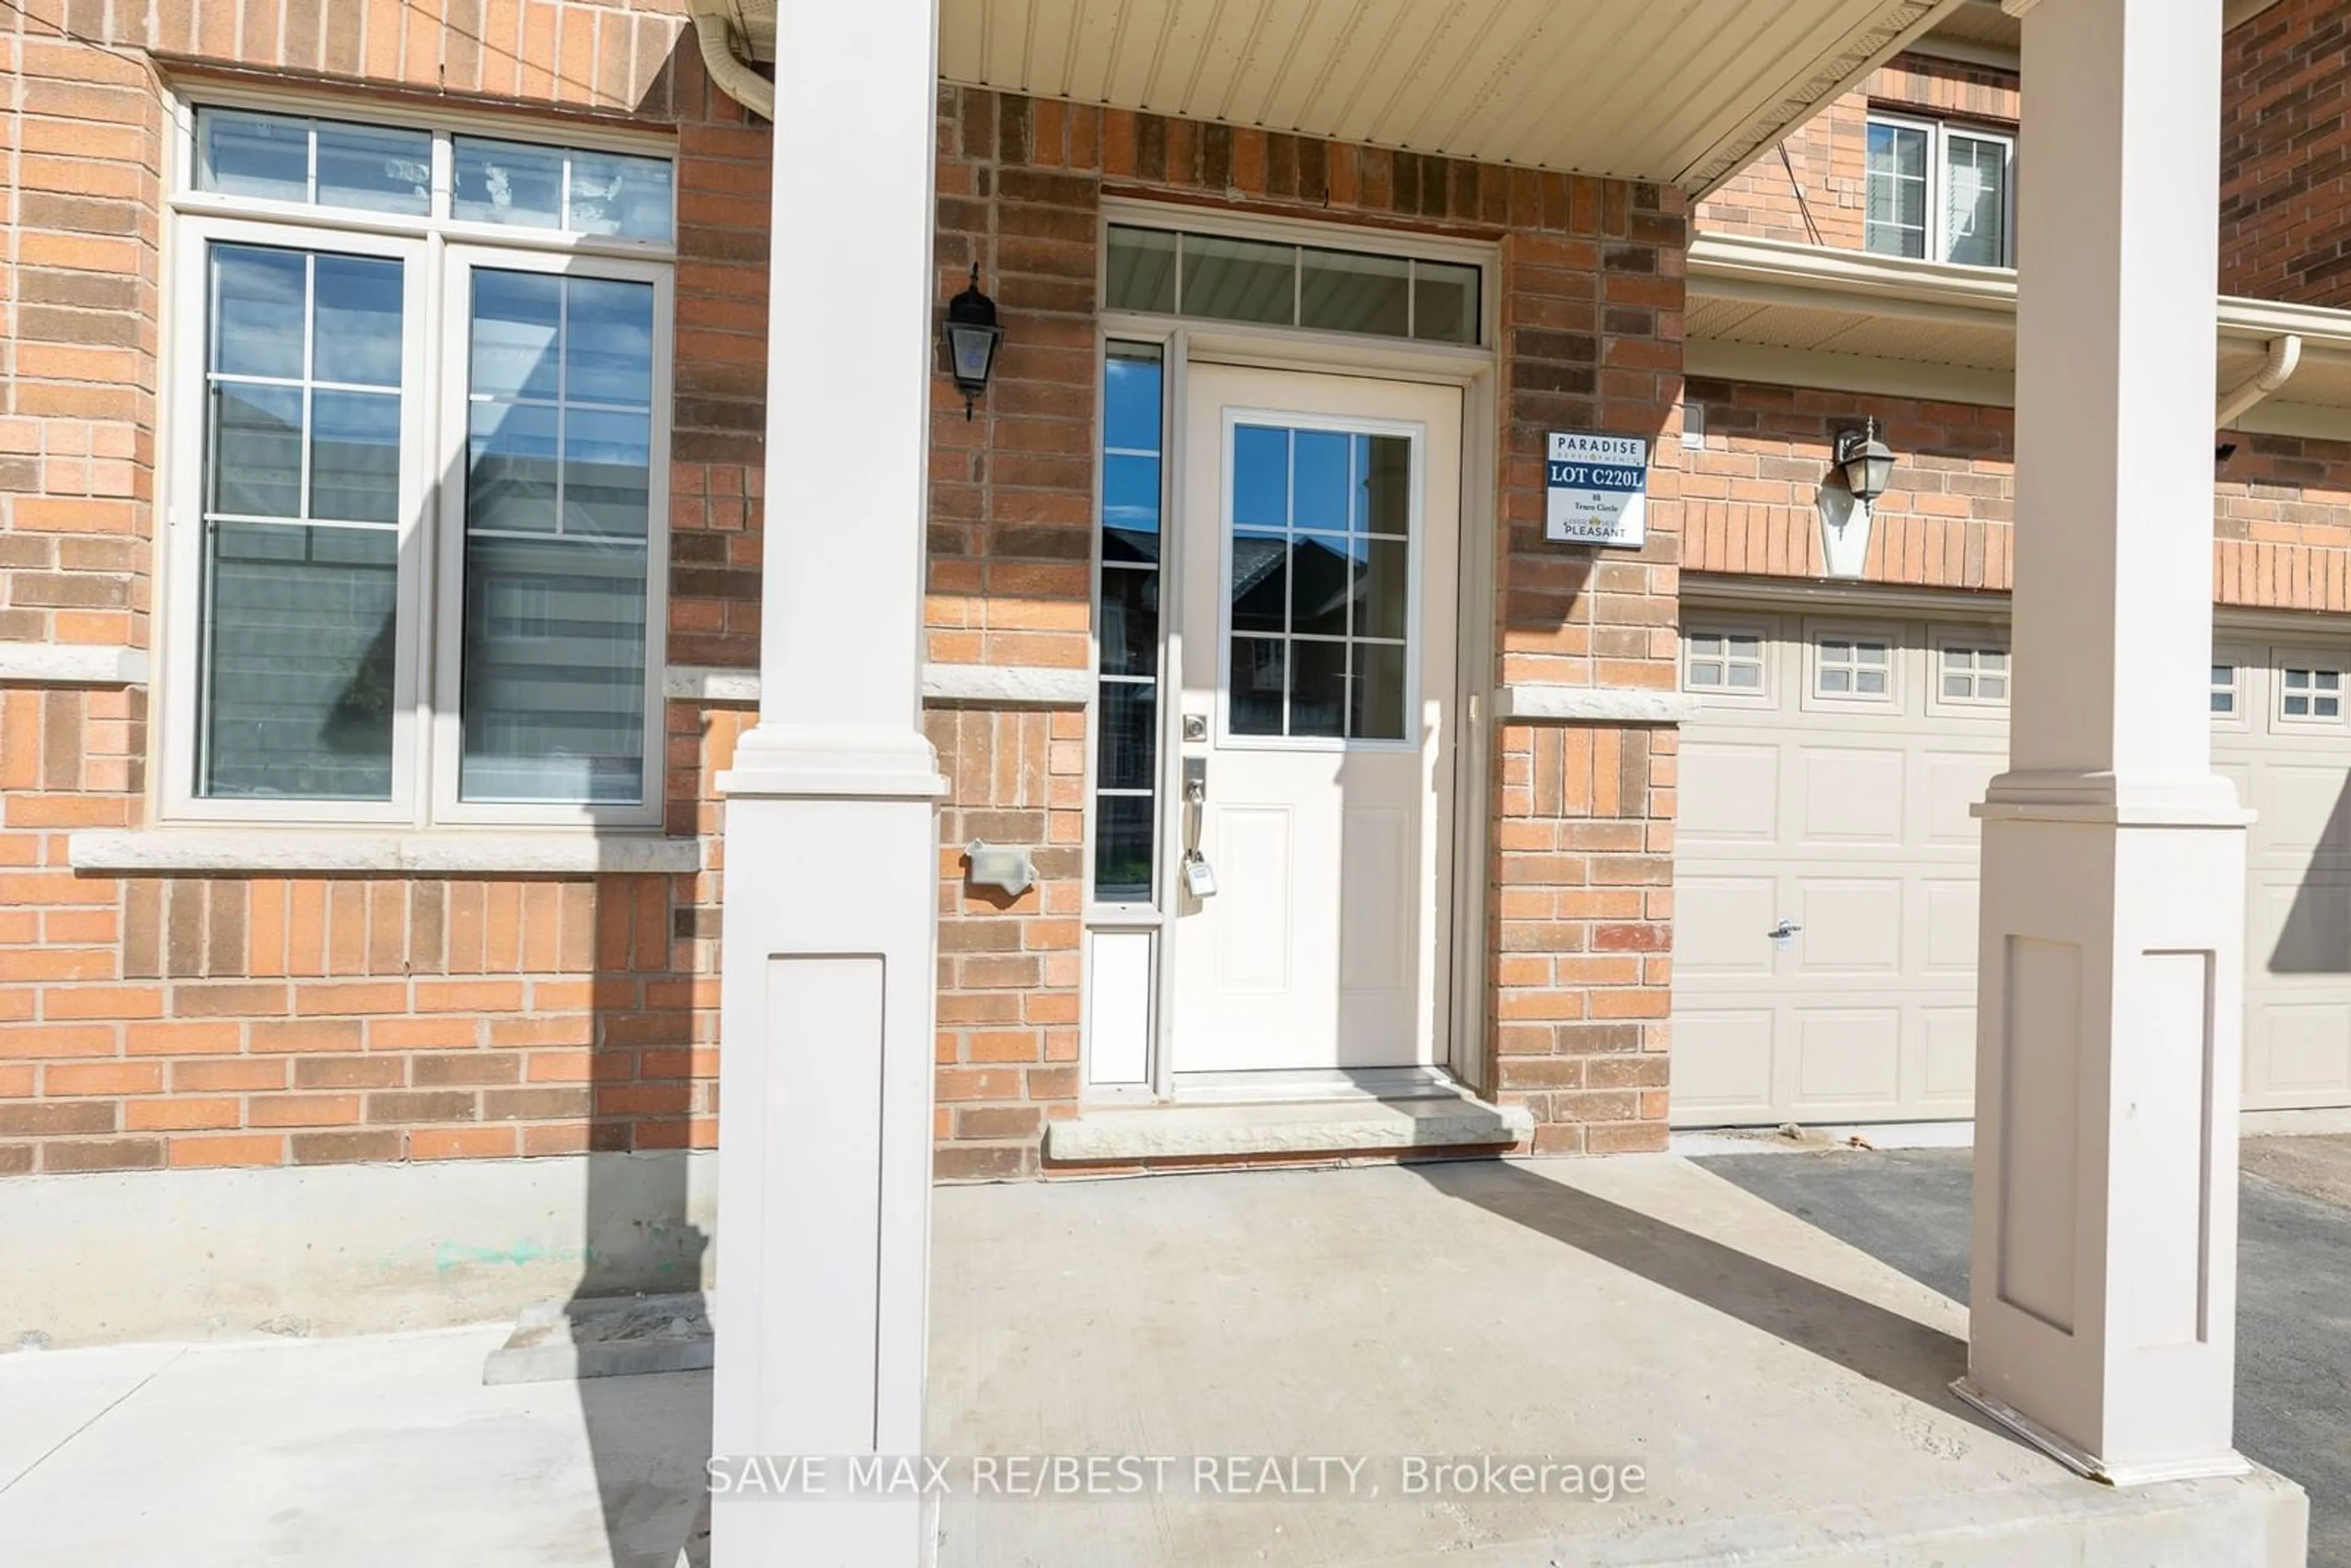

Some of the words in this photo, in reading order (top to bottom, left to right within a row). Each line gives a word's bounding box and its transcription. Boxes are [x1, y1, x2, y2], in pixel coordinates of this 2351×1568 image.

[1558, 437, 1637, 454] PARADISE
[1551, 466, 1588, 483] LOT
[1592, 468, 1643, 488] C220L
[1564, 525, 1625, 538] PLEASANT
